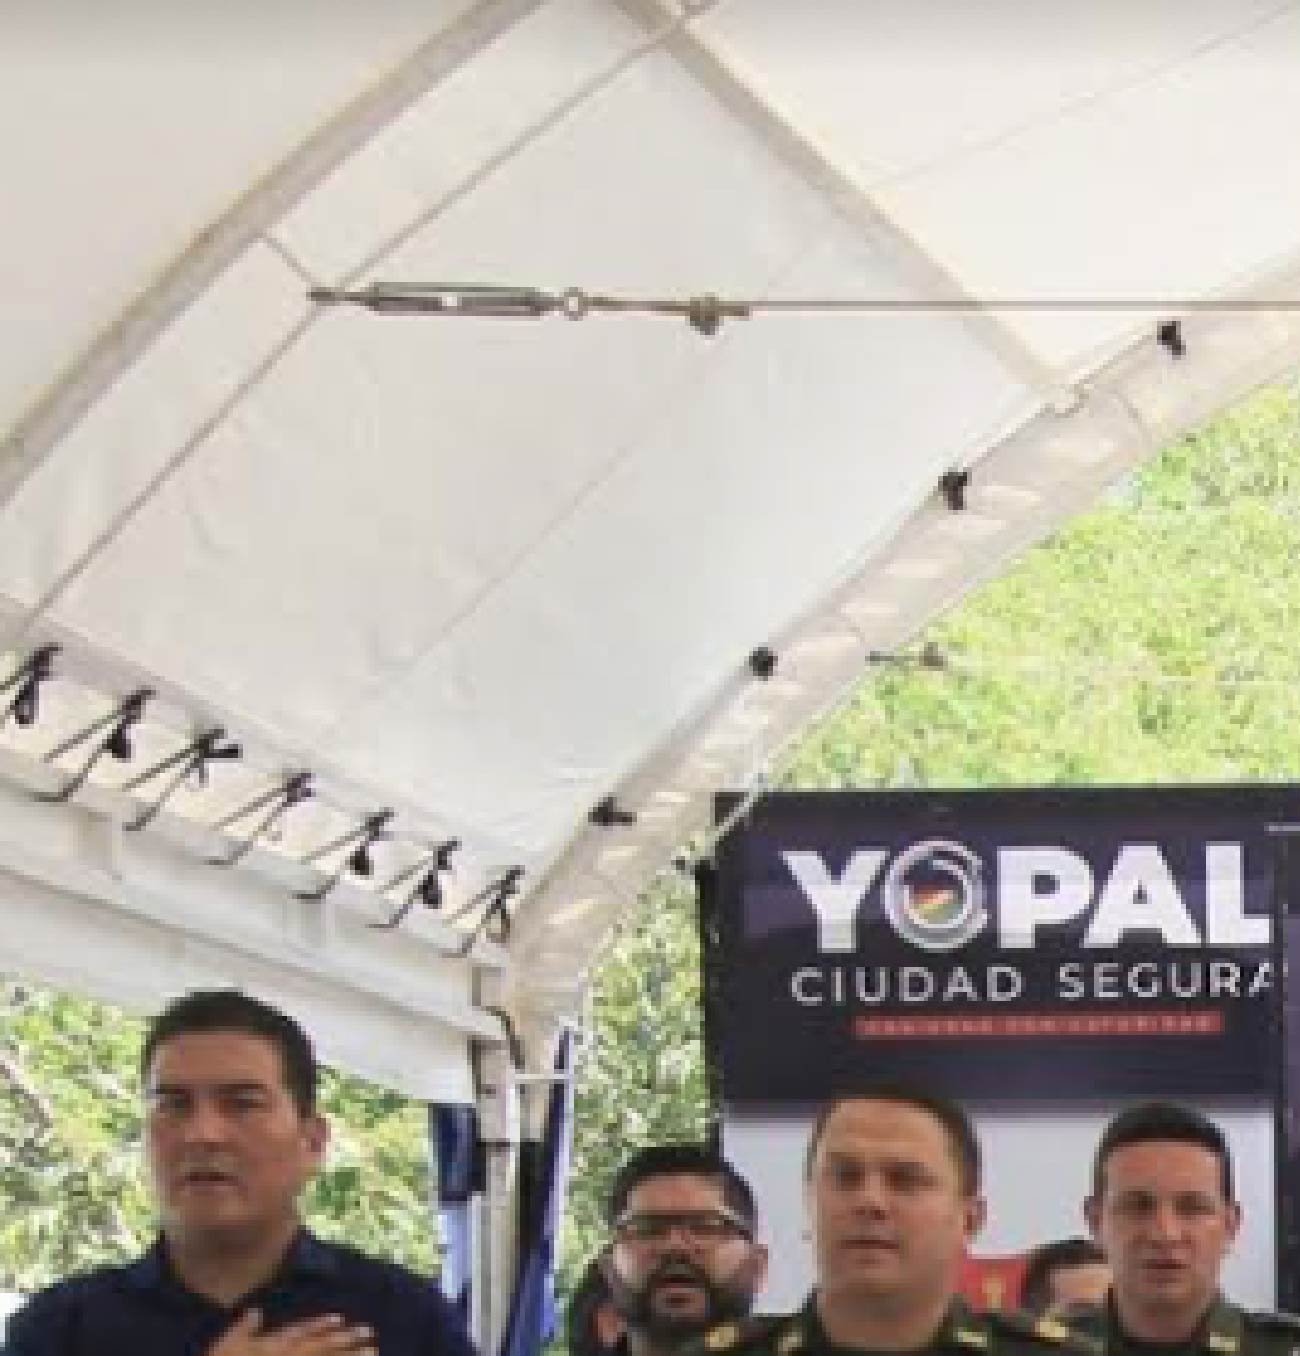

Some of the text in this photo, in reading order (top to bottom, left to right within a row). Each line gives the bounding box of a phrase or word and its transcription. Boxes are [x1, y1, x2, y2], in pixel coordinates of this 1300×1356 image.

[781, 840, 1272, 953] YOPAL
[791, 960, 1274, 1006] CIUDAD SEGURA
